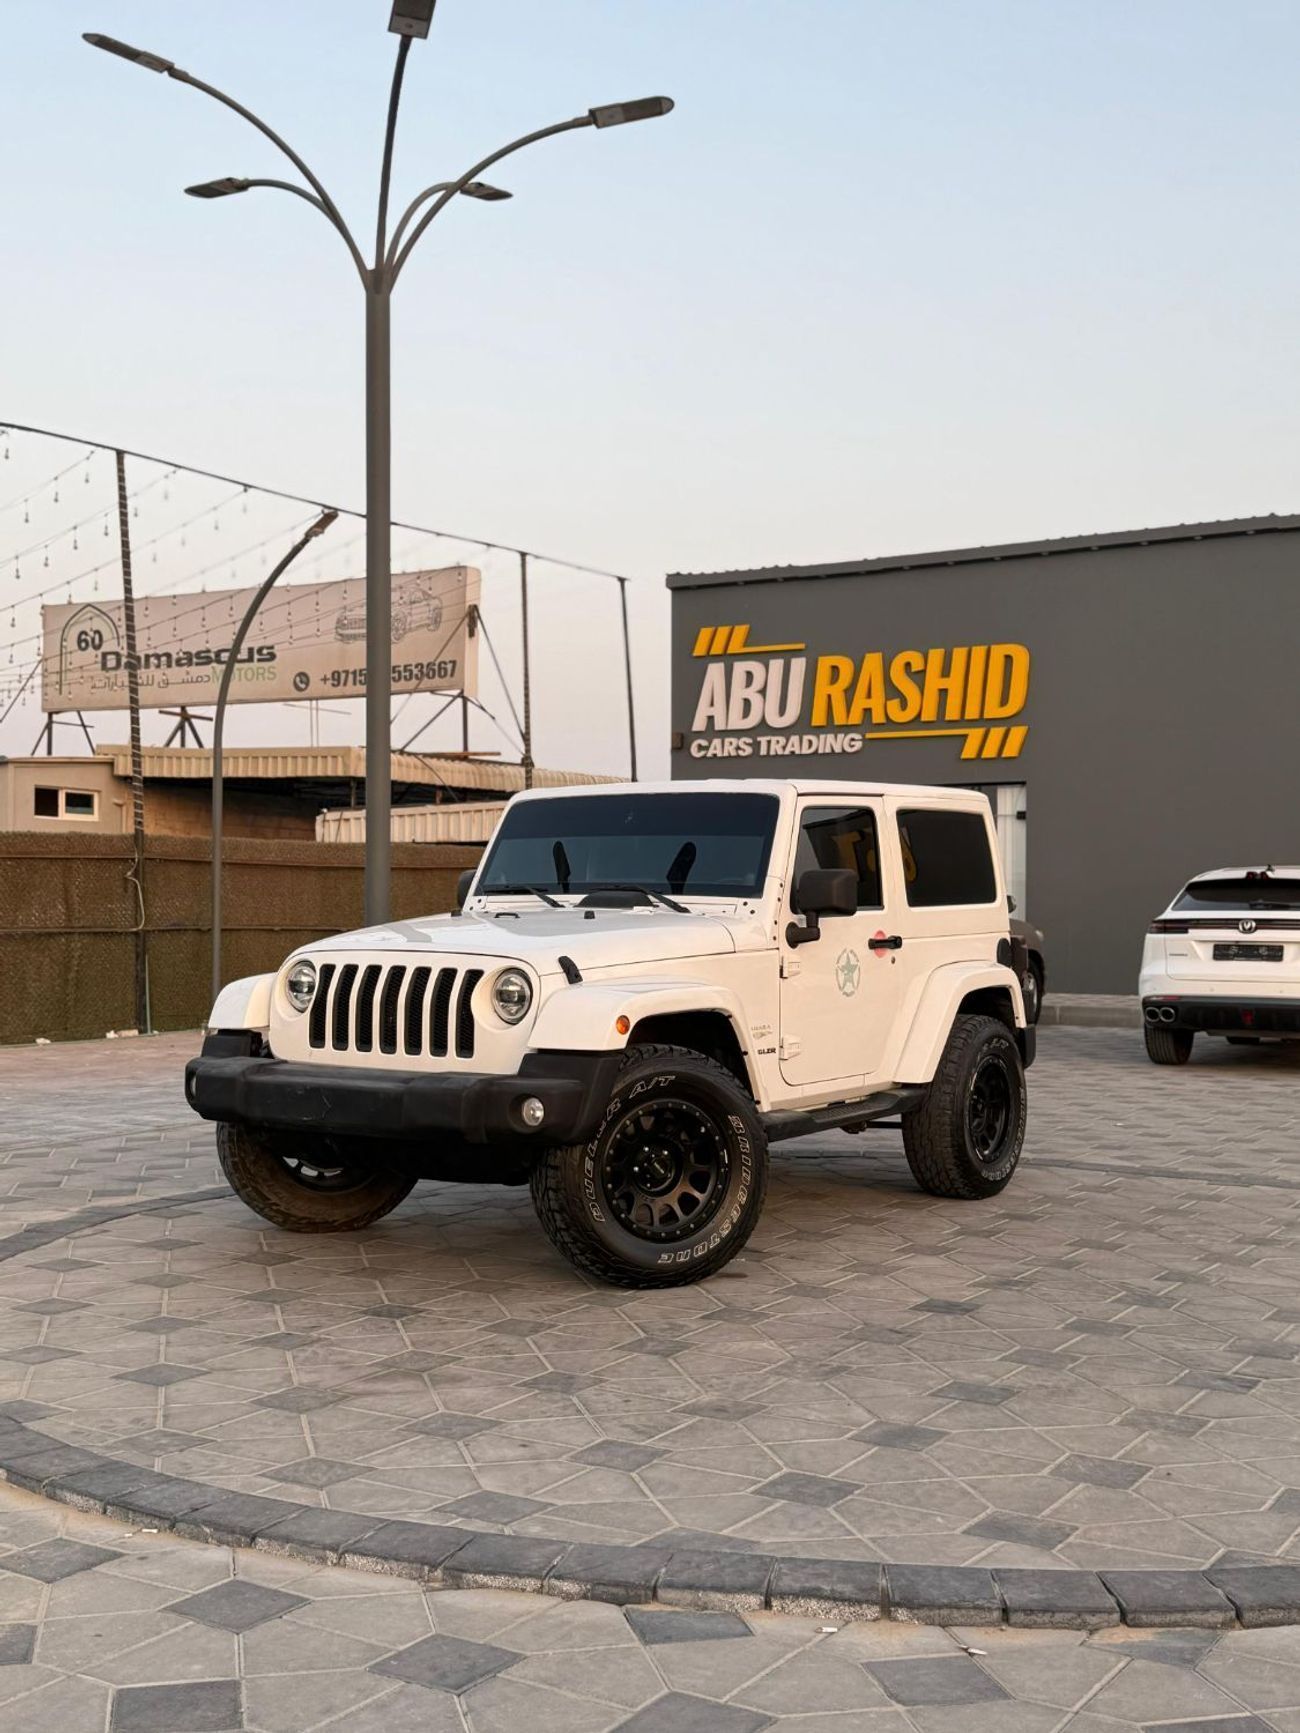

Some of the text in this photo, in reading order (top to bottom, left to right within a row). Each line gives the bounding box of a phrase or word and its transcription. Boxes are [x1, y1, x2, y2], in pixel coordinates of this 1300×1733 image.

[77, 629, 104, 652] 60
[211, 665, 277, 684] MTORS
[320, 660, 457, 687] +9715553667
[692, 643, 1030, 732] ABU RASHID
[690, 733, 864, 758] CARS TRADING
